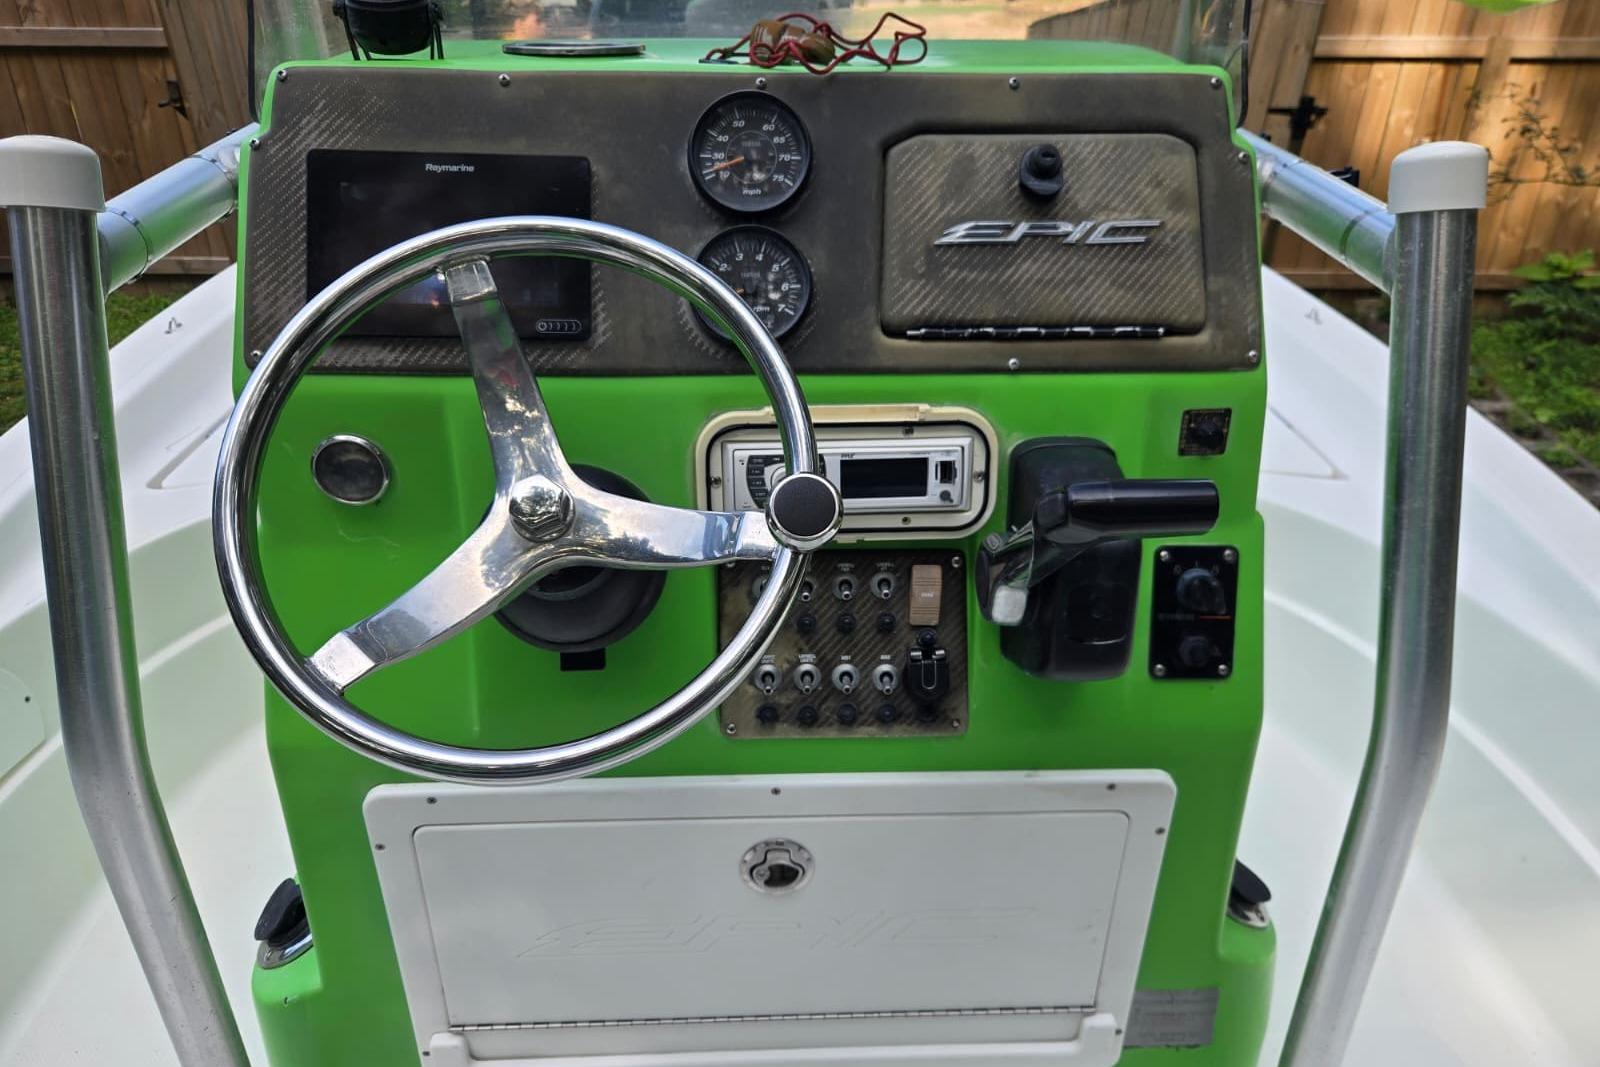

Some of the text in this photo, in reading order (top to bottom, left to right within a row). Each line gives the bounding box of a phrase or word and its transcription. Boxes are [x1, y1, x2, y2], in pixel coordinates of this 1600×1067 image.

[762, 124, 776, 132] 60
[716, 135, 729, 143] 40
[773, 136, 786, 144] 65
[712, 152, 725, 160] 30
[778, 154, 791, 162] 70
[425, 163, 475, 174] Raymarine
[772, 174, 785, 182] 75
[742, 187, 762, 196] mph
[934, 220, 1163, 245] EPIC
[735, 253, 744, 261] 3
[755, 253, 764, 262] 4
[719, 262, 728, 271] 2
[771, 264, 780, 272] 5
[781, 282, 790, 292] 6
[752, 304, 770, 313] rpm
[777, 303, 786, 312] 7
